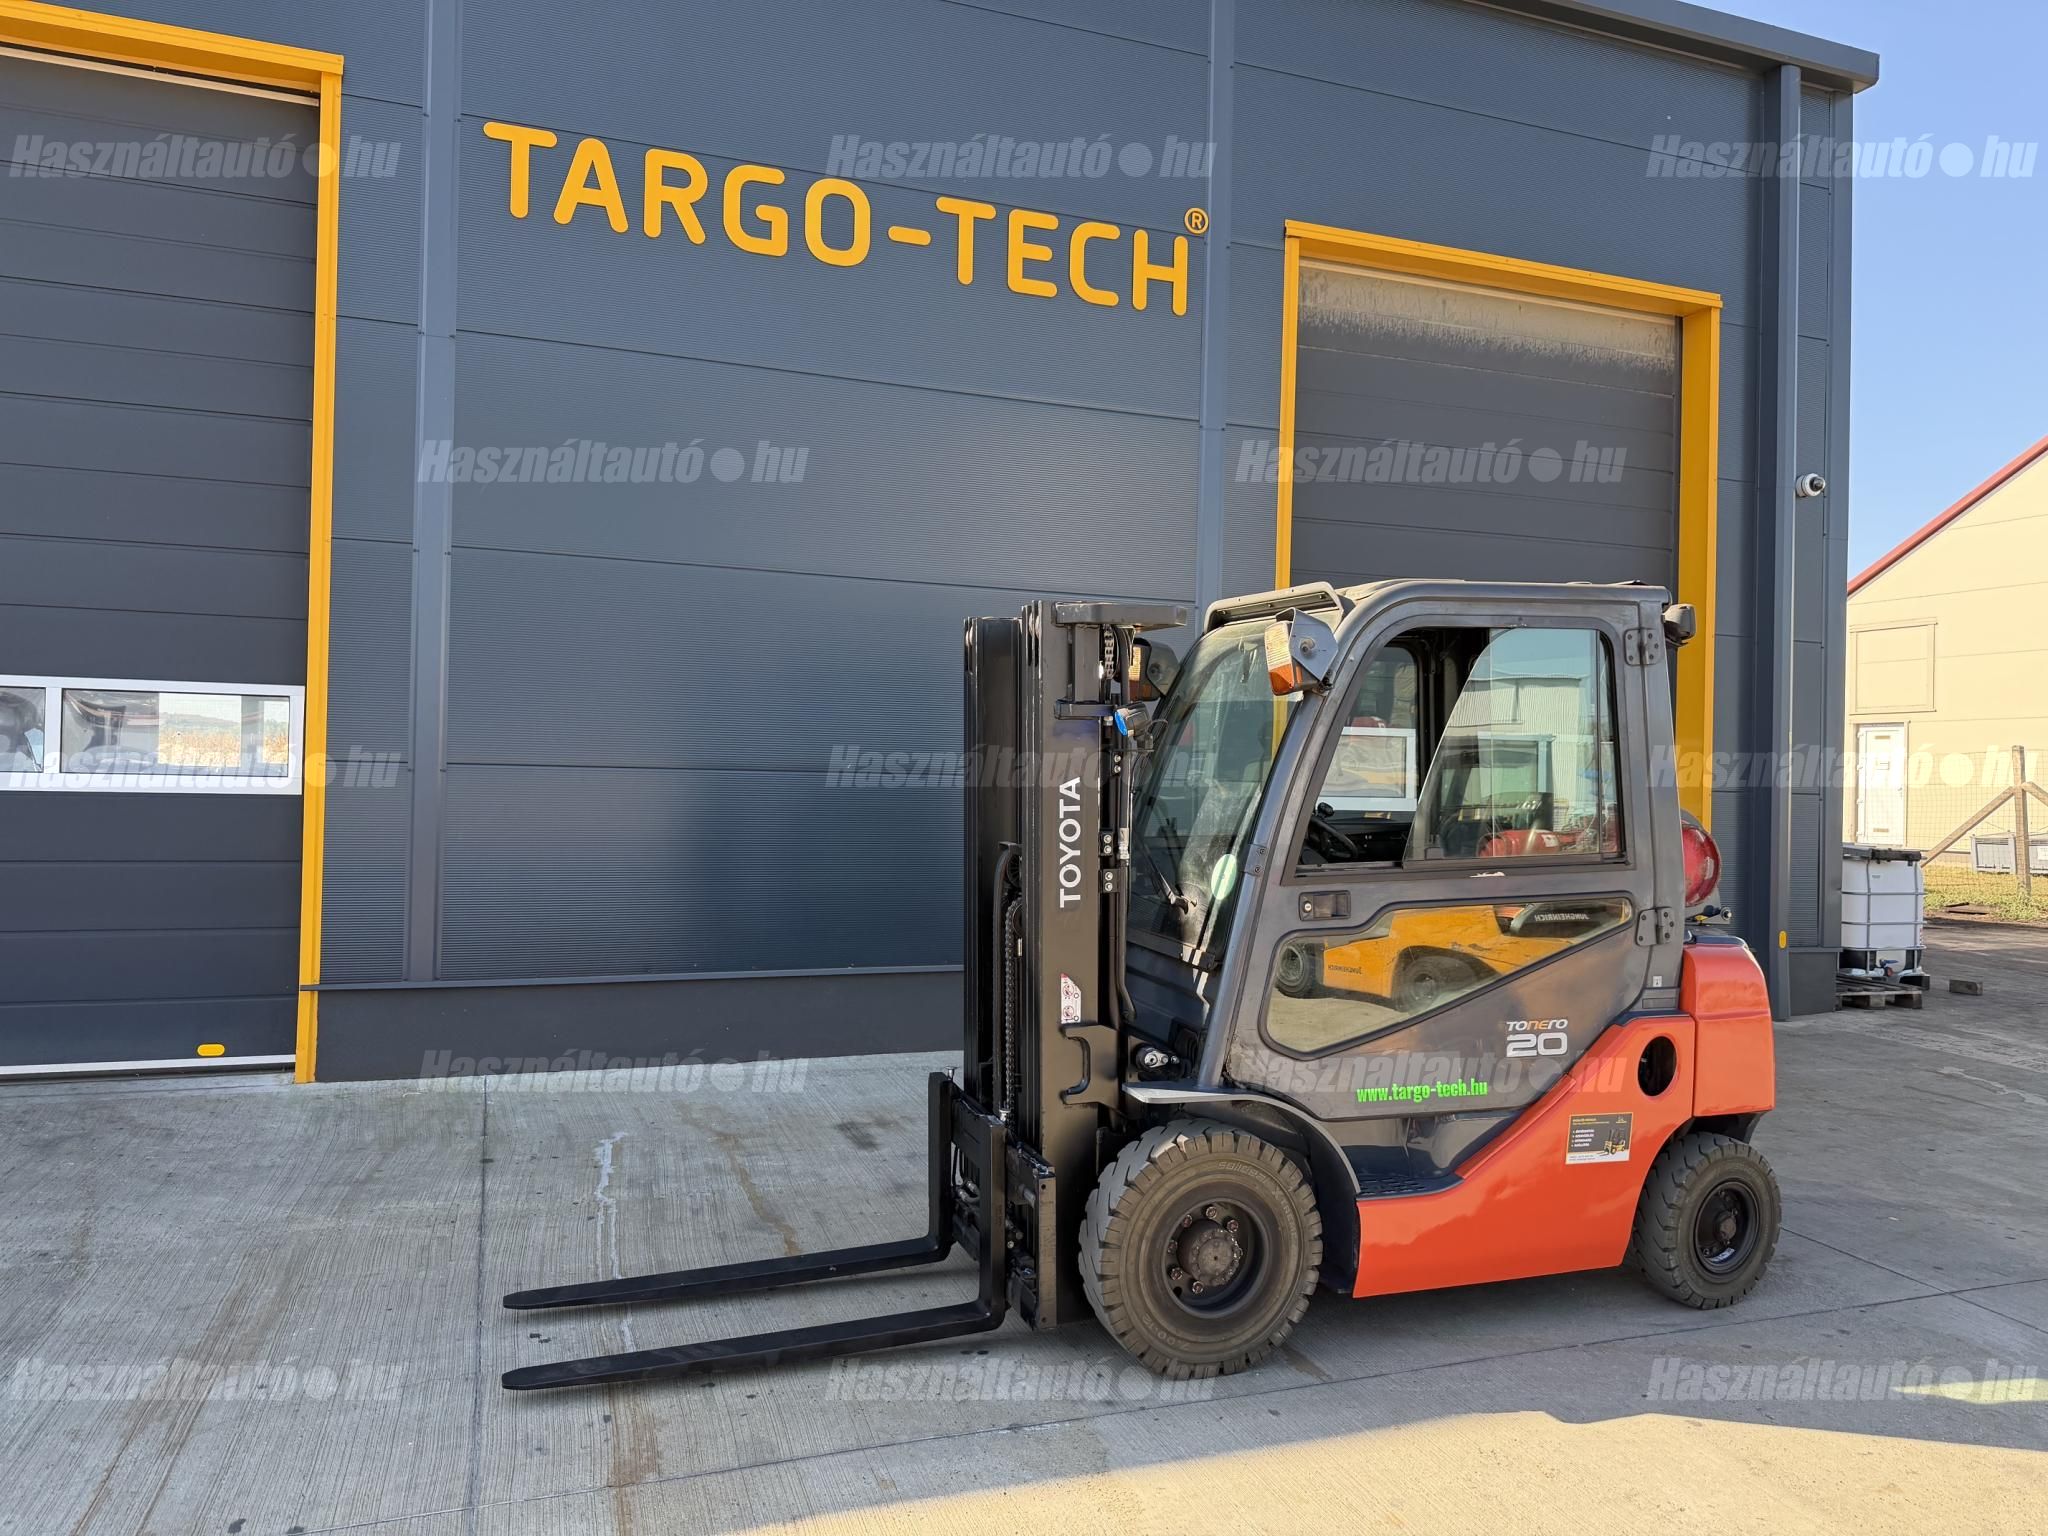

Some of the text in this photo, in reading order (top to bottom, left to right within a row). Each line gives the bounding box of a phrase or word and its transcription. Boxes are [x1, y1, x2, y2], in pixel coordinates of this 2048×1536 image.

[1059, 777, 1081, 908] TOYOTA
[1507, 1032, 1567, 1057] 20
[1356, 1078, 1488, 1103] www.targo-tech.hu
